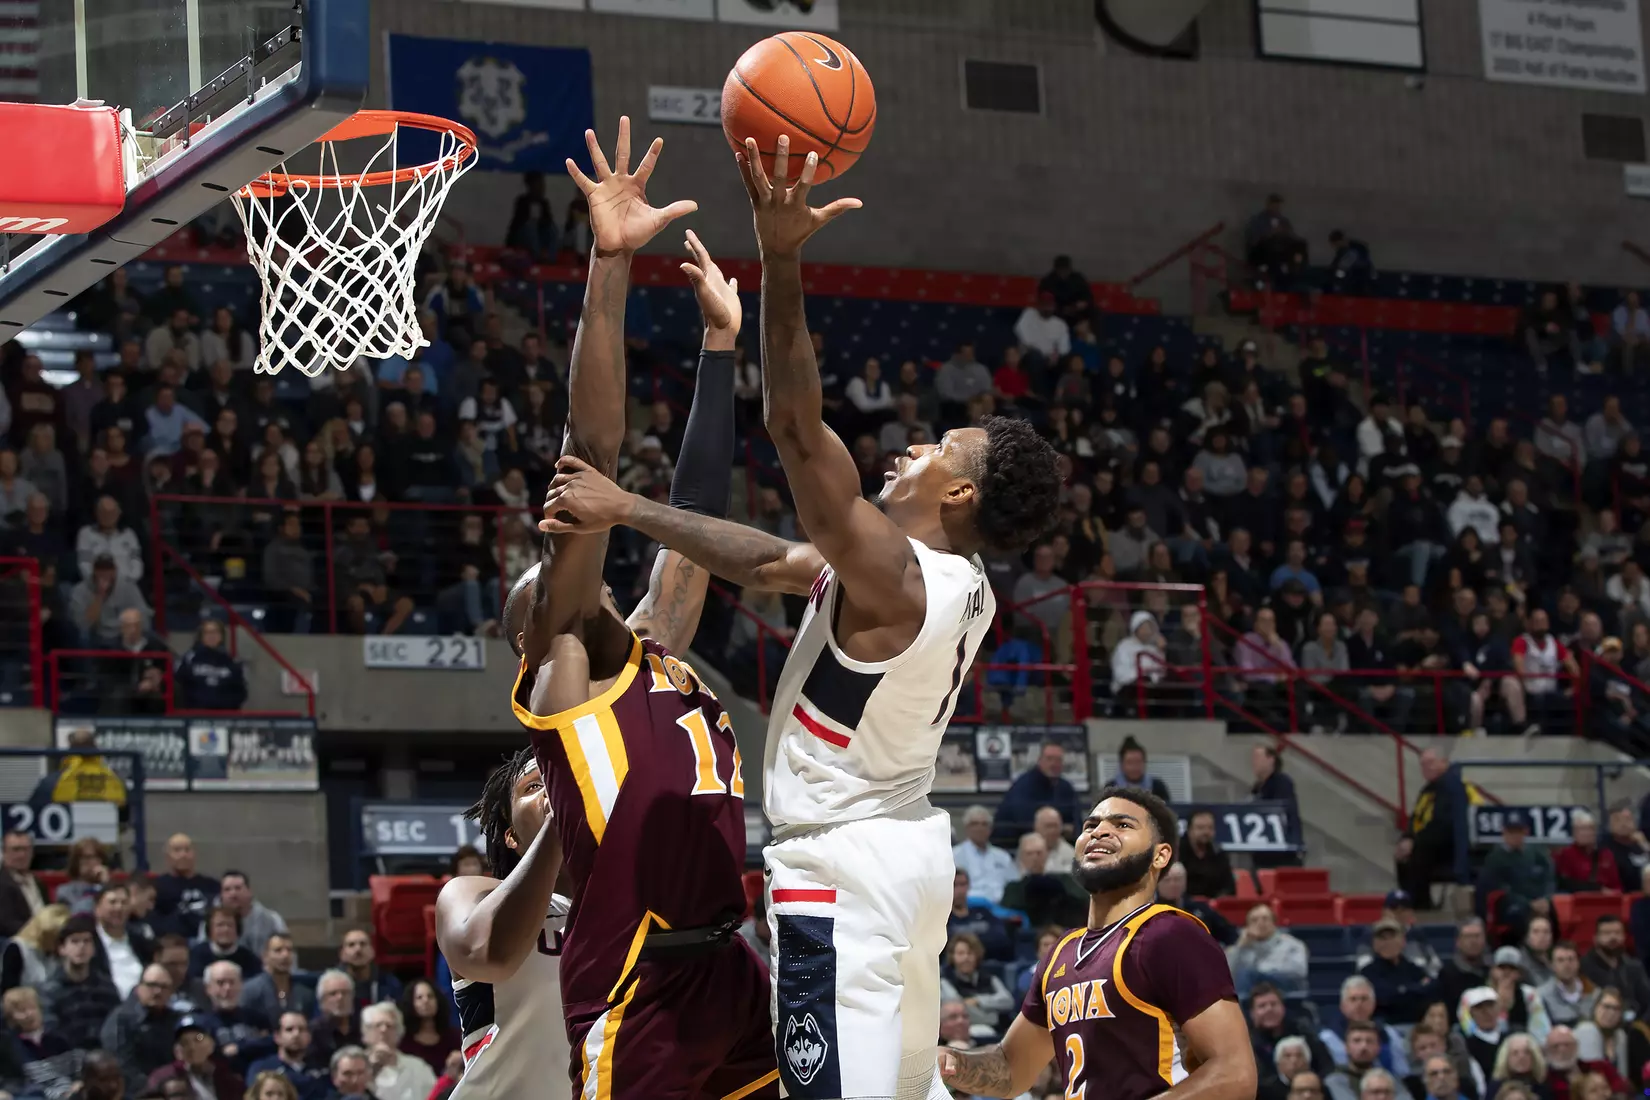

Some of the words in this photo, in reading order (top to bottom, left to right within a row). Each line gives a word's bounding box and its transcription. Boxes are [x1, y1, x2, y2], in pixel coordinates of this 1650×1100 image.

[369, 641, 408, 662] SEC
[427, 637, 483, 668] 221
[931, 630, 968, 726] 1
[376, 820, 427, 842] SEC
[1223, 812, 1285, 846] 121
[1045, 979, 1117, 1033] IONA
[1064, 1033, 1087, 1100] 2
